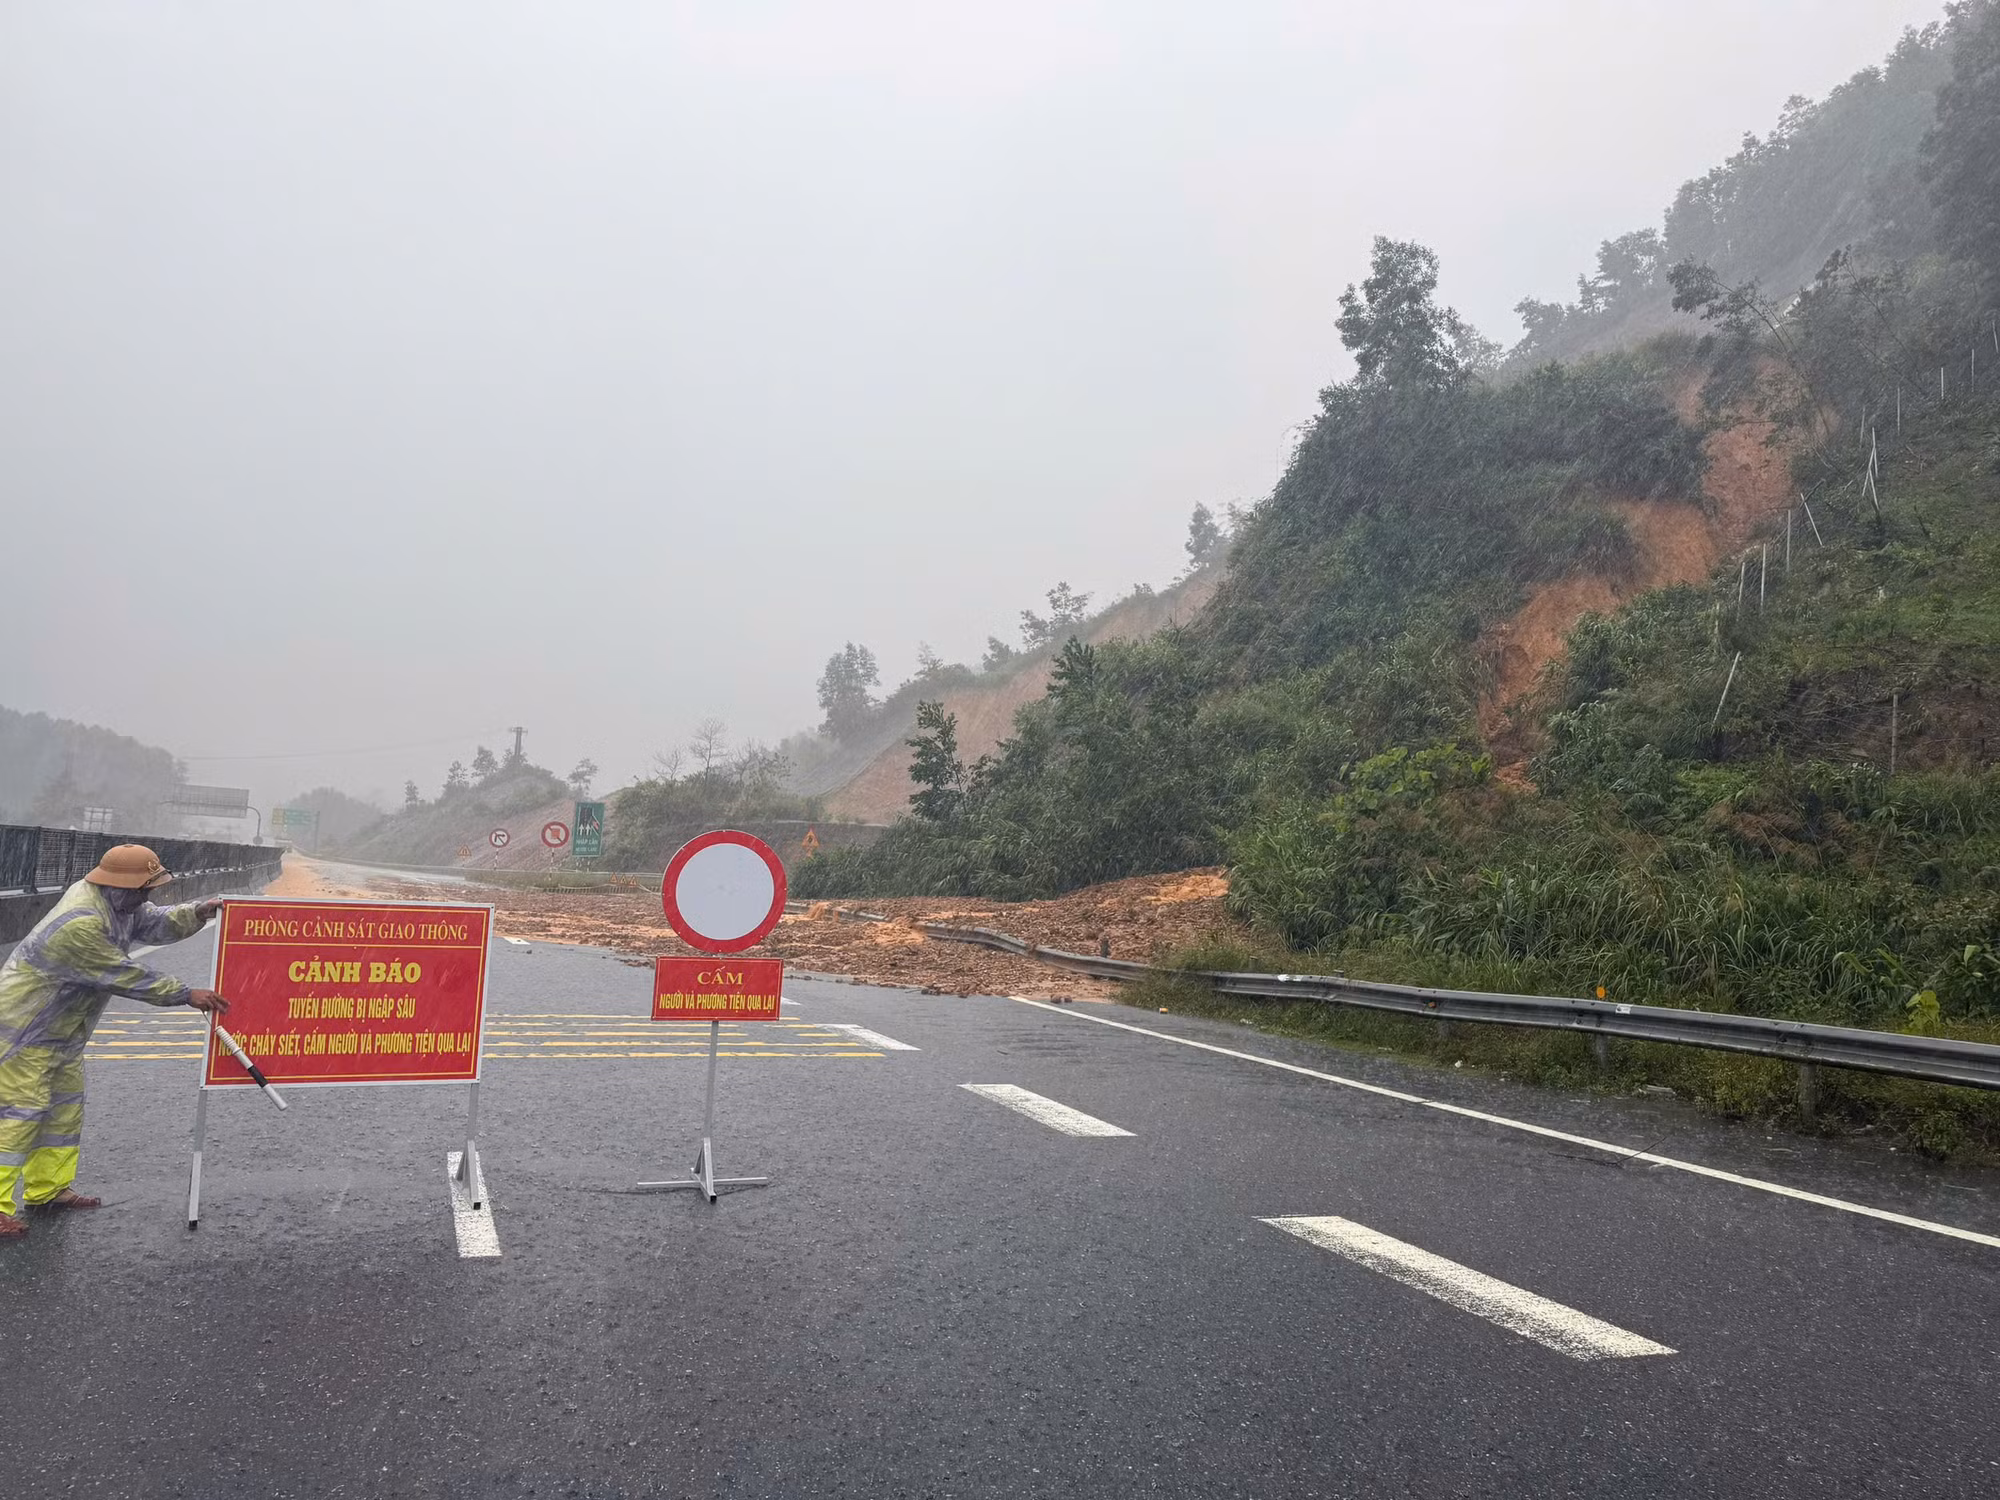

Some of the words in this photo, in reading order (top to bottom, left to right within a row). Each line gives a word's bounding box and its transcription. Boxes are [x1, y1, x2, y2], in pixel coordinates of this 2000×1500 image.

[244, 915, 298, 938] PHÒNG
[302, 915, 345, 938] CẢNH
[347, 917, 376, 939] SÁT
[378, 922, 415, 940] GIAO
[418, 919, 468, 941] THÔNG
[288, 955, 361, 983] CẢNH
[368, 957, 422, 983] BÁO
[697, 965, 744, 985] CẤM
[288, 991, 319, 1019] TUYẾN
[321, 992, 354, 1019] ĐƯỜNG
[356, 998, 367, 1023] BỊ
[368, 993, 394, 1023] NGẬP
[396, 993, 416, 1019] SÂU
[659, 990, 684, 1009] NGƯỜI
[685, 990, 695, 1009] VÀ
[697, 991, 727, 1010] PHƯƠNG
[729, 991, 745, 1013] TIỆN
[747, 994, 762, 1012] QUA
[763, 995, 775, 1013] LẠI
[249, 1027, 276, 1056] CHẢY
[278, 1027, 300, 1058] SIẾT,
[303, 1026, 326, 1055] CẤM
[328, 1028, 358, 1054] NGƯỜI
[361, 1028, 372, 1054] VÀ
[374, 1030, 413, 1054] PHƯƠNG
[415, 1028, 435, 1058] TIỆN
[437, 1032, 455, 1055] QUA
[456, 1032, 471, 1057] LẠI
